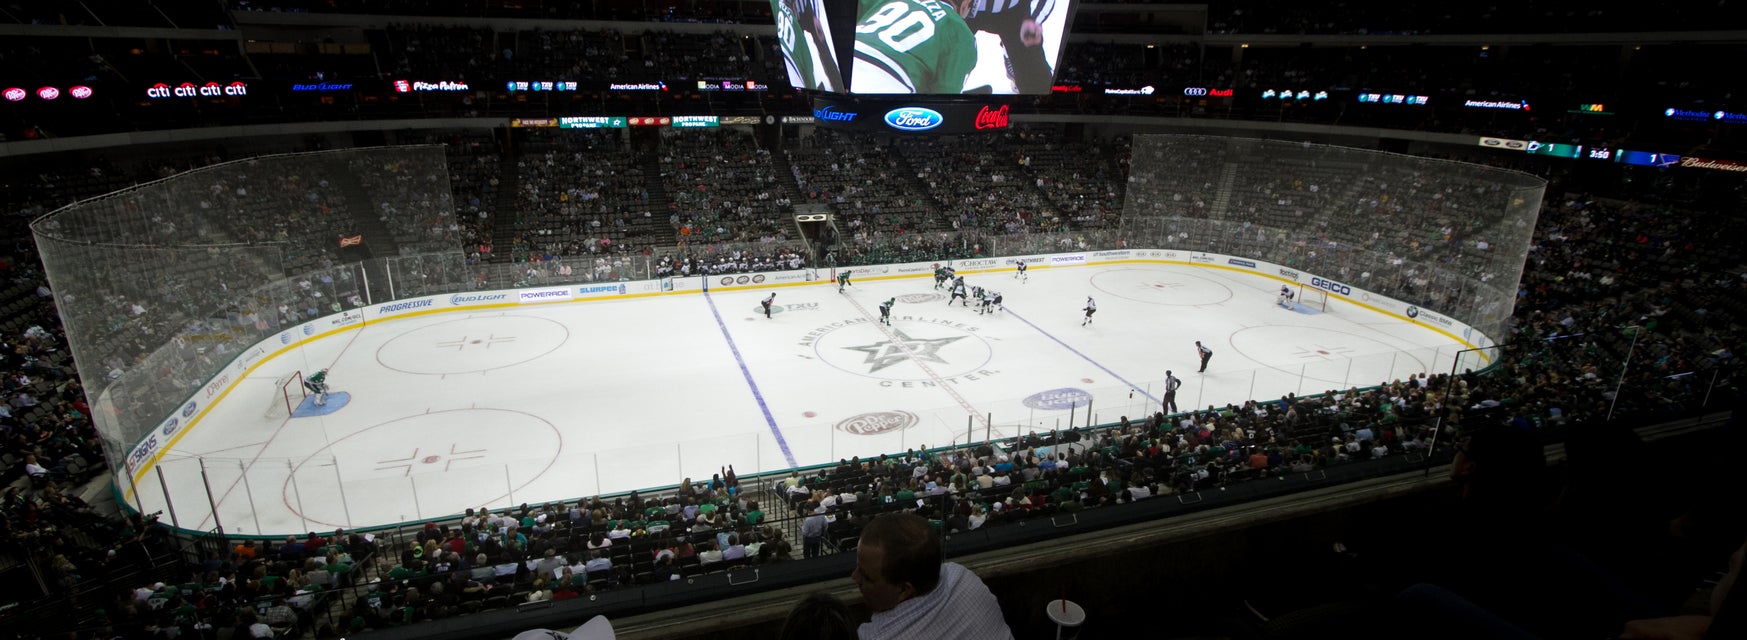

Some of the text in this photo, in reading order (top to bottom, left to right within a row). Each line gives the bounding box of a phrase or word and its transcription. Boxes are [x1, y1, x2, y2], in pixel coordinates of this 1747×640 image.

[856, 1, 936, 53] 90
[147, 83, 246, 97] citi citi citi citi
[321, 83, 352, 91] LIGHT
[413, 81, 438, 91] Pizza
[1209, 88, 1233, 96] Audi
[1465, 100, 1521, 109] American Airlines
[824, 110, 858, 121] LIGHT
[896, 110, 931, 126] Ford
[1590, 150, 1609, 159] 3:50
[1681, 156, 1747, 172] Budweiser
[1312, 277, 1351, 296] GEICO
[477, 294, 507, 302] LIGHT
[521, 290, 569, 299] POWERADE
[379, 299, 433, 314] PROGRESSIVE
[785, 302, 819, 310] TXU
[798, 317, 867, 348] AMERICAN
[879, 368, 994, 389] CENTER
[1038, 396, 1087, 407] LIGHT
[1042, 392, 1080, 400] BUD
[853, 415, 903, 434] Pepper
